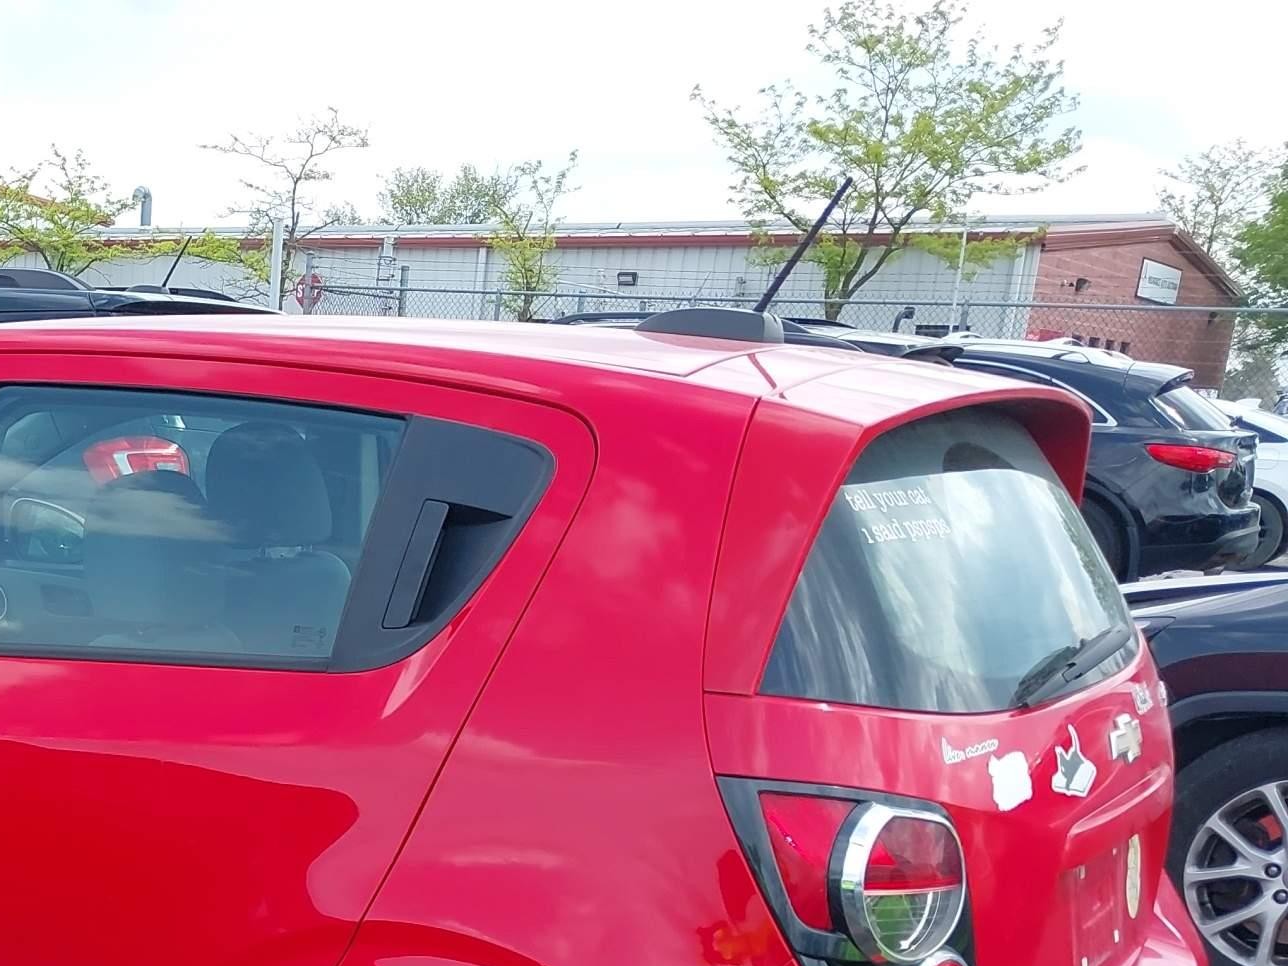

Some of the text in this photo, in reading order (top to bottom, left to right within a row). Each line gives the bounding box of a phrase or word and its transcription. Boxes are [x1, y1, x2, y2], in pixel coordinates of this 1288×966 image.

[844, 486, 932, 512] tell your cat
[872, 518, 907, 543] said
